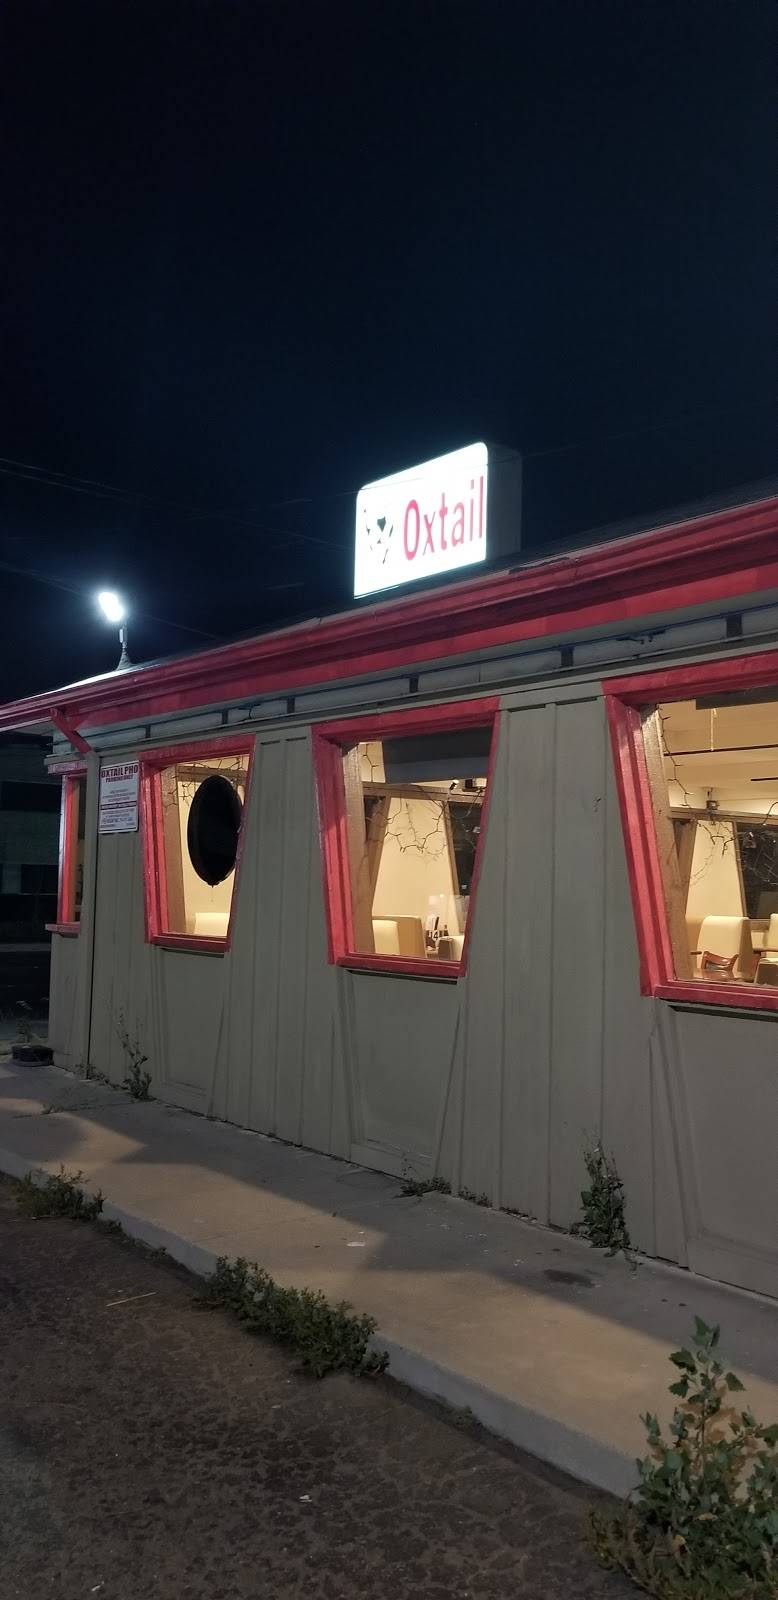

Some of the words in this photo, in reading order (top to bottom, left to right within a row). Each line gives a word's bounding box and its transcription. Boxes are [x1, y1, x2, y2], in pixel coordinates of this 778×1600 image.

[403, 475, 484, 561] Oxtail
[101, 768, 123, 777] OXTAIL
[124, 765, 138, 774] PHO
